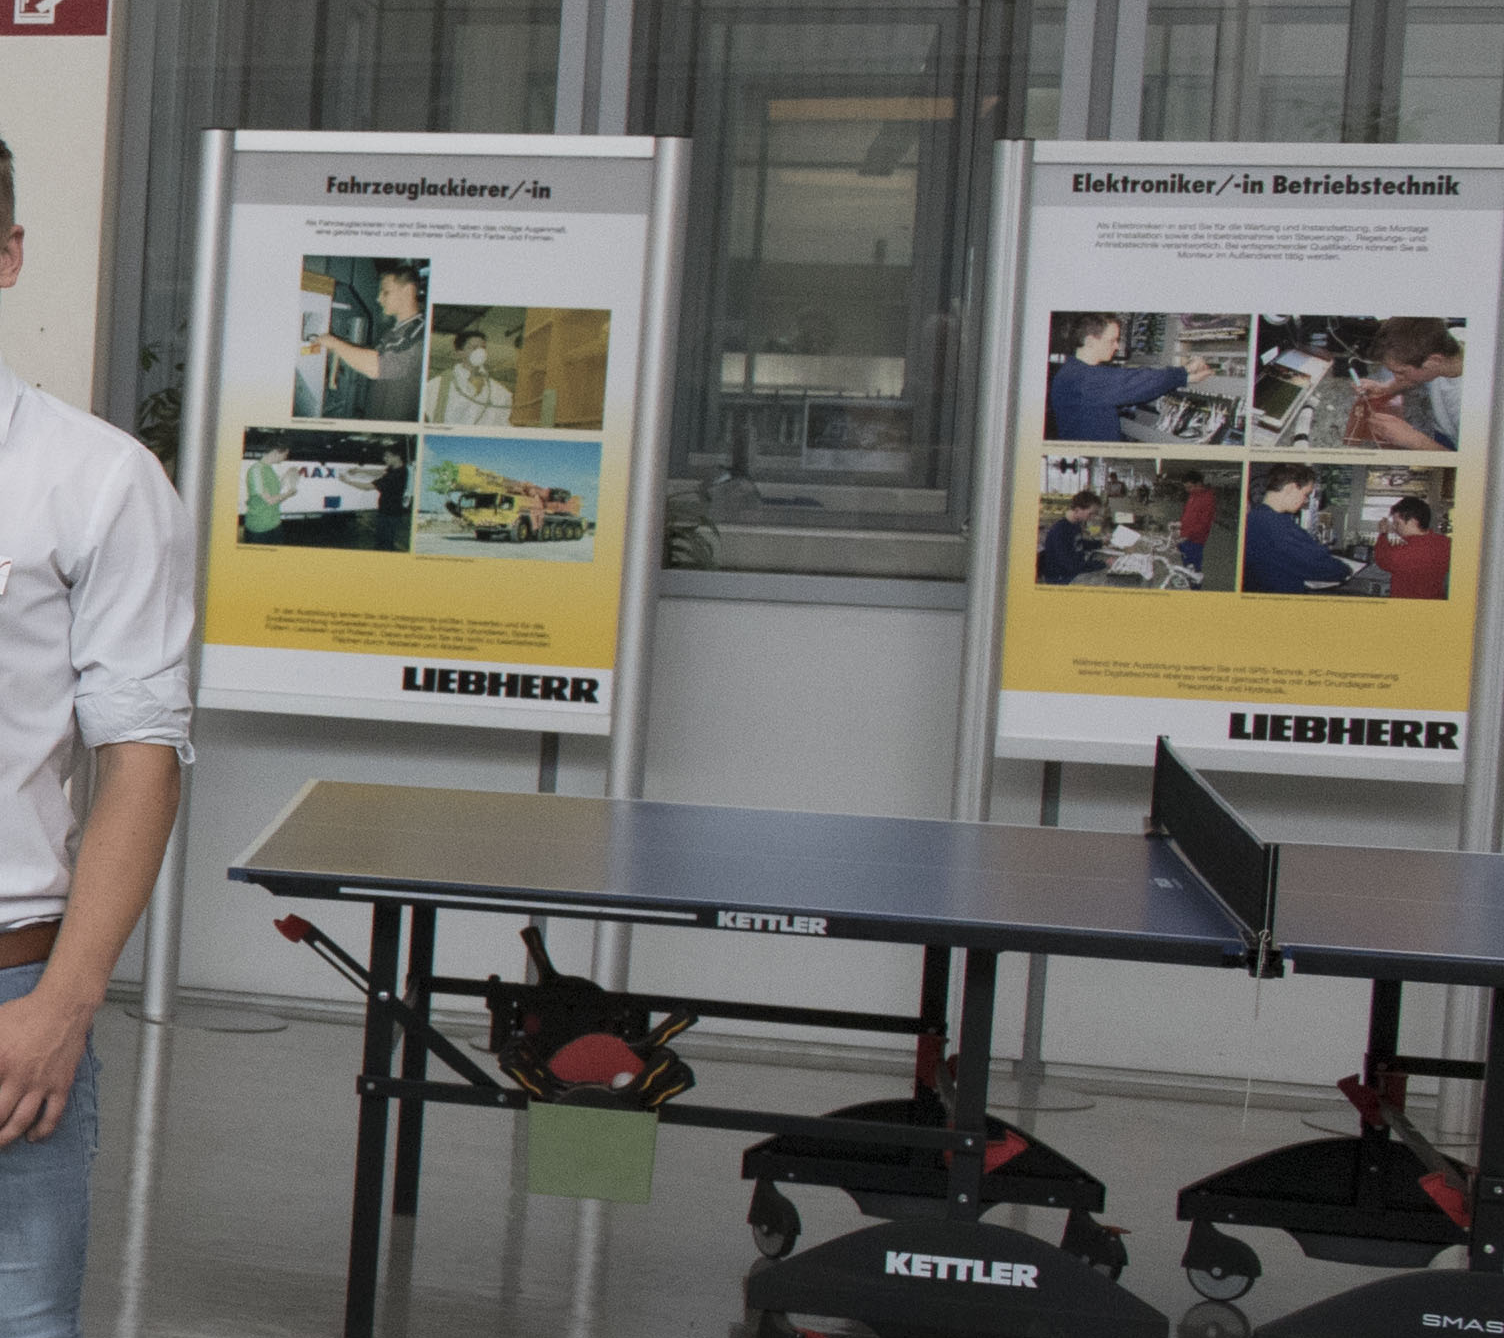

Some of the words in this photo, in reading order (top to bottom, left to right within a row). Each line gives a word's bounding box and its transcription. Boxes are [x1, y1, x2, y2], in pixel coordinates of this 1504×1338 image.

[325, 176, 552, 201] Fahrzeuglackierer/-in
[1072, 173, 1264, 196] Elektroniker/-in
[1272, 174, 1461, 196] Betriebstechnik
[402, 666, 599, 703] LIEBHERR
[1229, 711, 1459, 749] LIEBHERR
[717, 911, 827, 935] KETTLER
[885, 1251, 1038, 1289] KETTLER
